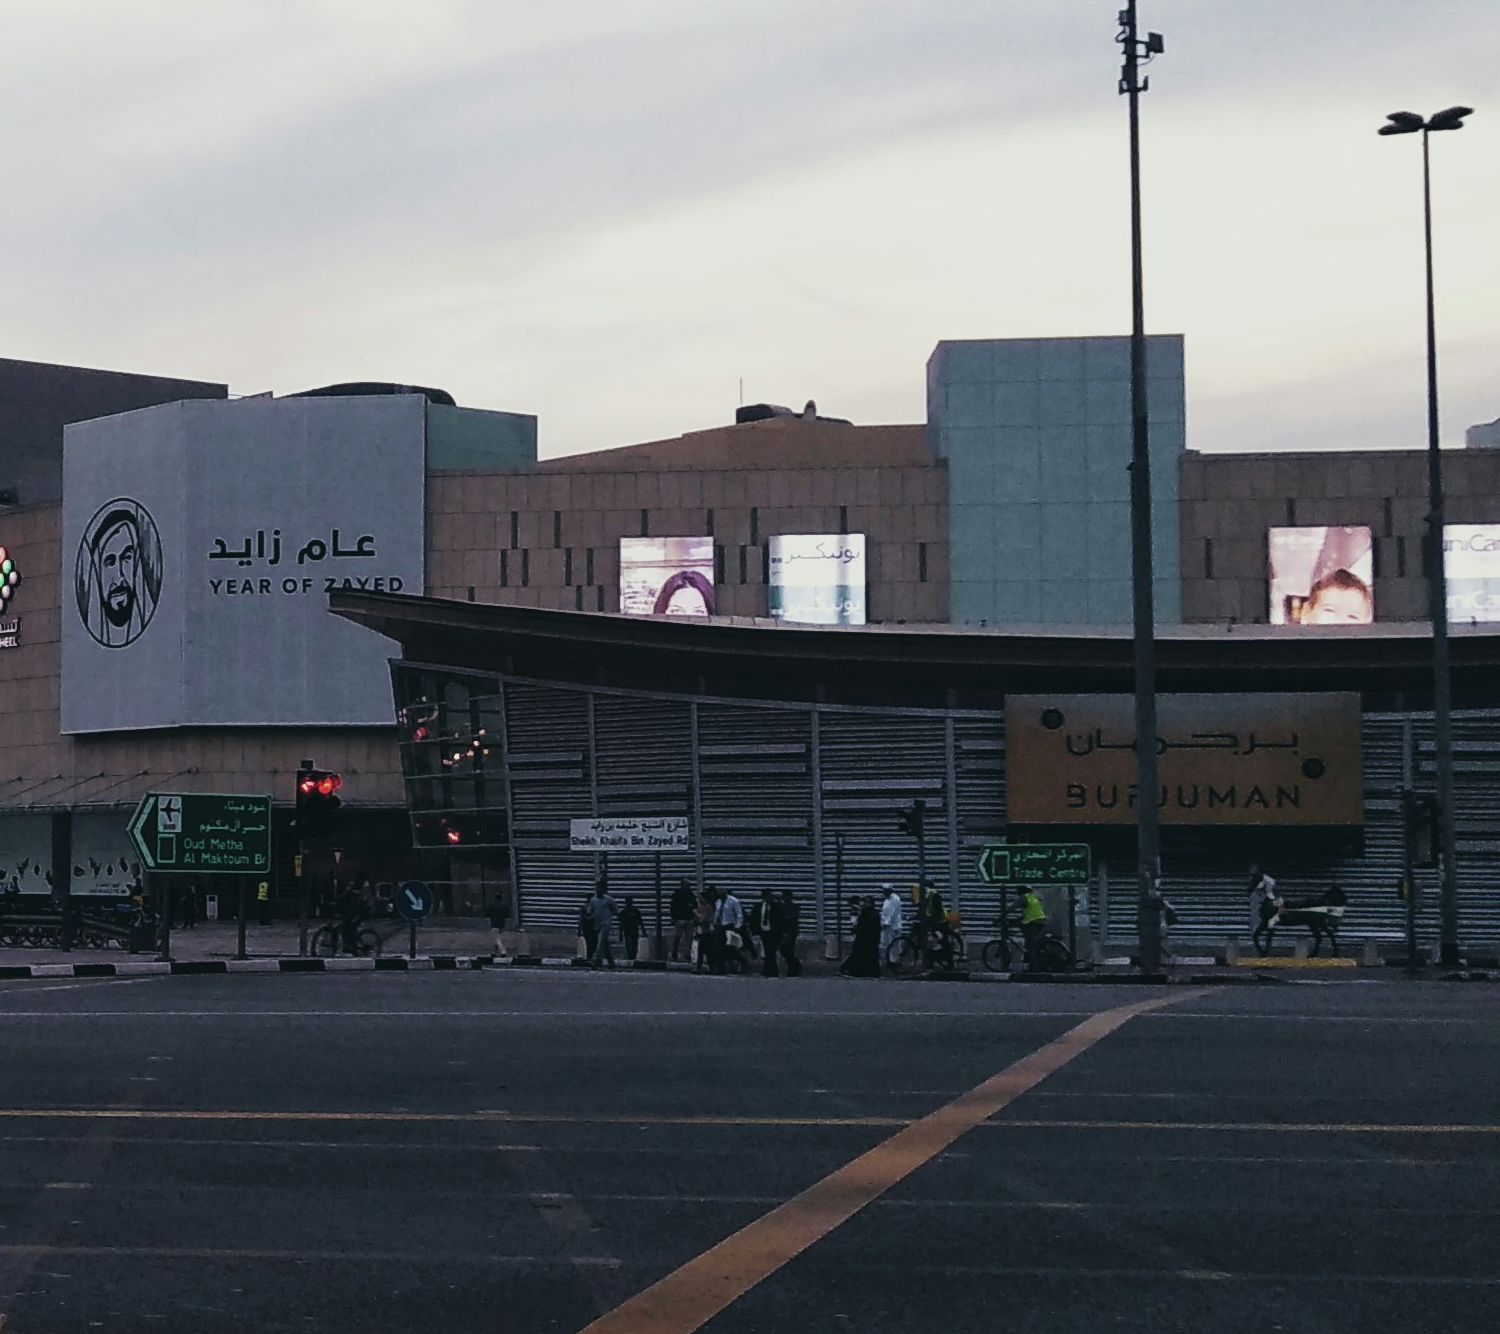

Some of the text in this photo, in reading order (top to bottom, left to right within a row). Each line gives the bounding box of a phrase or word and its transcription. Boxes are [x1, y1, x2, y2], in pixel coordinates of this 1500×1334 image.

[209, 529, 376, 567] عام زايد
[209, 576, 404, 595] YEAR OF ZAYED
[183, 837, 244, 851] Oud Metha
[571, 836, 597, 846] Sheikh
[631, 836, 644, 846] Bin
[648, 836, 673, 848] Zayed
[676, 836, 688, 846] Rd
[183, 852, 196, 864] Al
[200, 853, 250, 865] Maktoum
